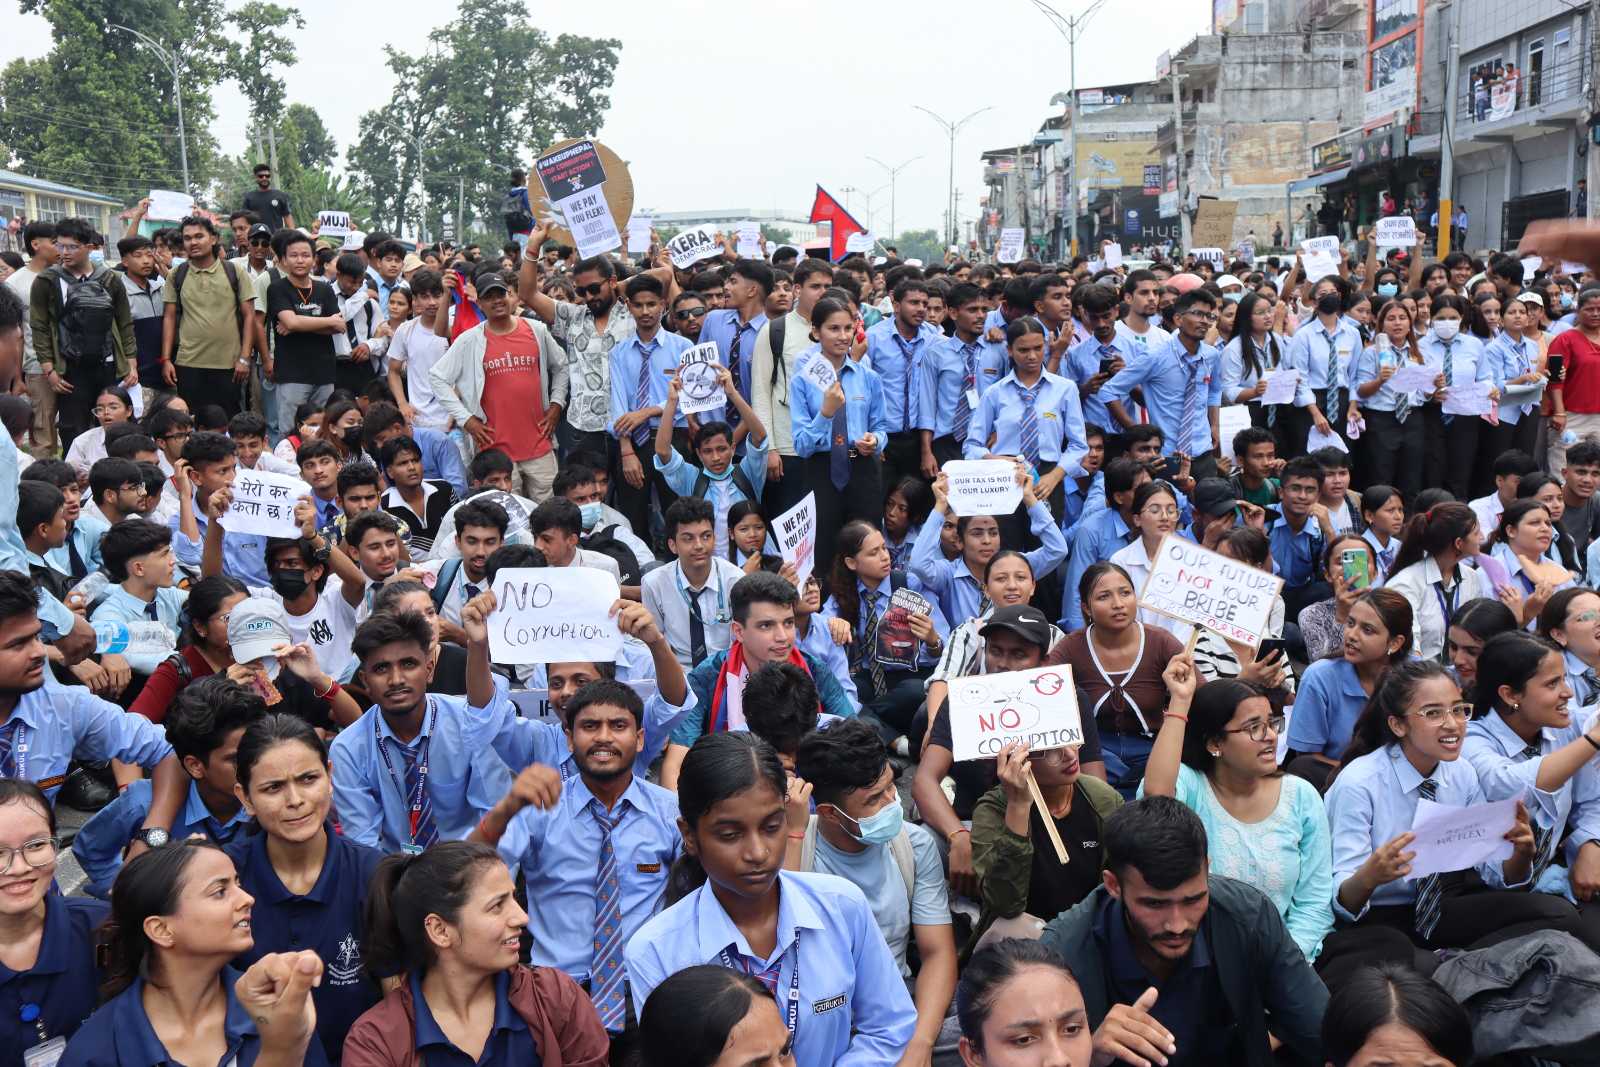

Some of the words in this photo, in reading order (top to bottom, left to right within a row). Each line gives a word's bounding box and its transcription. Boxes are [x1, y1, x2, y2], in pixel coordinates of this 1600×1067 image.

[569, 200, 583, 213] WE
[583, 194, 597, 208] PAY
[320, 215, 349, 228] MUJI
[572, 213, 586, 224] YOU
[668, 230, 711, 257] KERA
[674, 242, 718, 265] DEMOCRAC
[699, 346, 716, 363] NO
[240, 477, 265, 497] मेरो
[269, 485, 292, 499] कर
[954, 477, 970, 485] OUR
[980, 486, 1010, 494] LUXURY
[232, 500, 262, 517] कता
[267, 504, 280, 520] छ
[782, 517, 796, 534] WE
[796, 505, 808, 524] PAY
[784, 533, 798, 550] YOU
[1169, 544, 1210, 569] OUR
[498, 581, 553, 613] NO
[1177, 568, 1213, 590] NOT
[1222, 585, 1259, 608] YOUR
[1183, 590, 1239, 622] BRIBE
[978, 708, 1021, 733] NO
[814, 995, 845, 1013] GURUKUL
